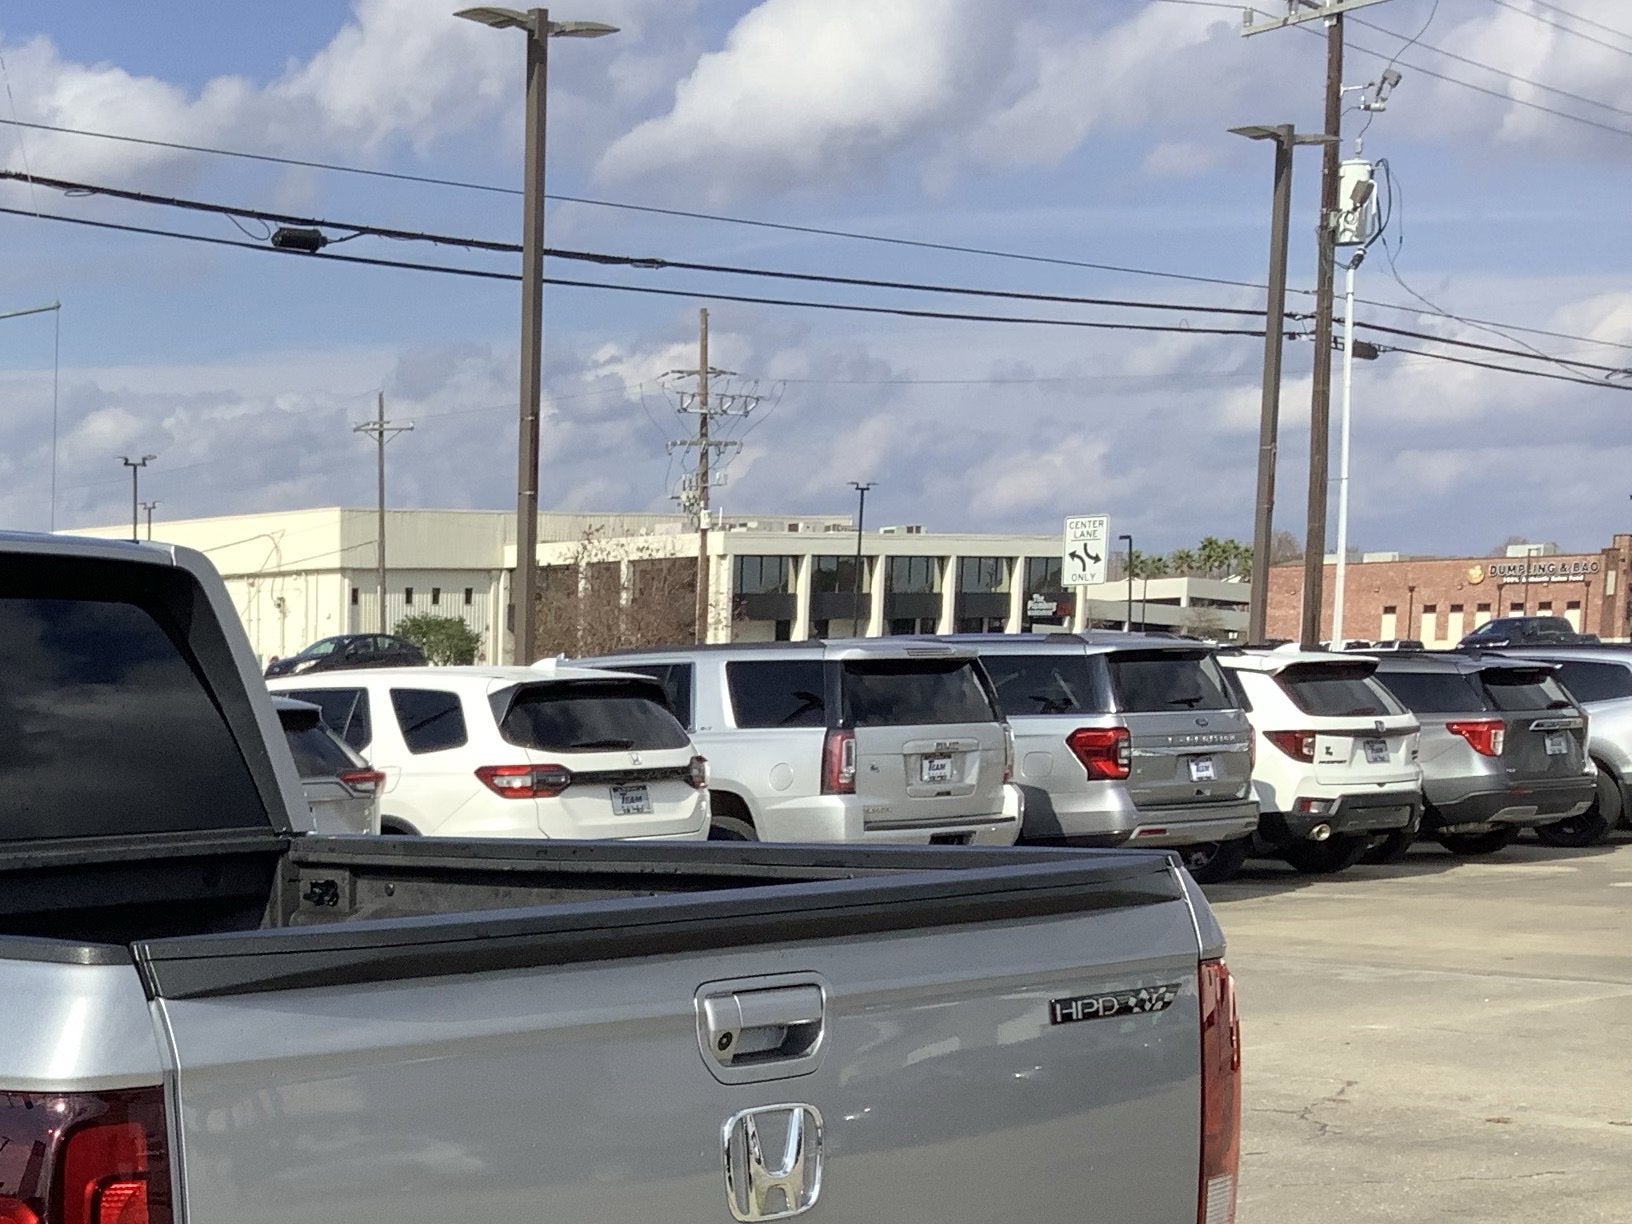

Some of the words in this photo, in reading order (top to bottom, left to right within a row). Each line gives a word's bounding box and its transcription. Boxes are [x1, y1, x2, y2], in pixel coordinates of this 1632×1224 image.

[1069, 519, 1104, 530] CENTER
[1074, 529, 1098, 539] LANE
[1571, 561, 1601, 575] BAO
[1071, 573, 1096, 582] ONLY
[619, 793, 643, 804] TEAM
[1055, 996, 1119, 1022] HPD
